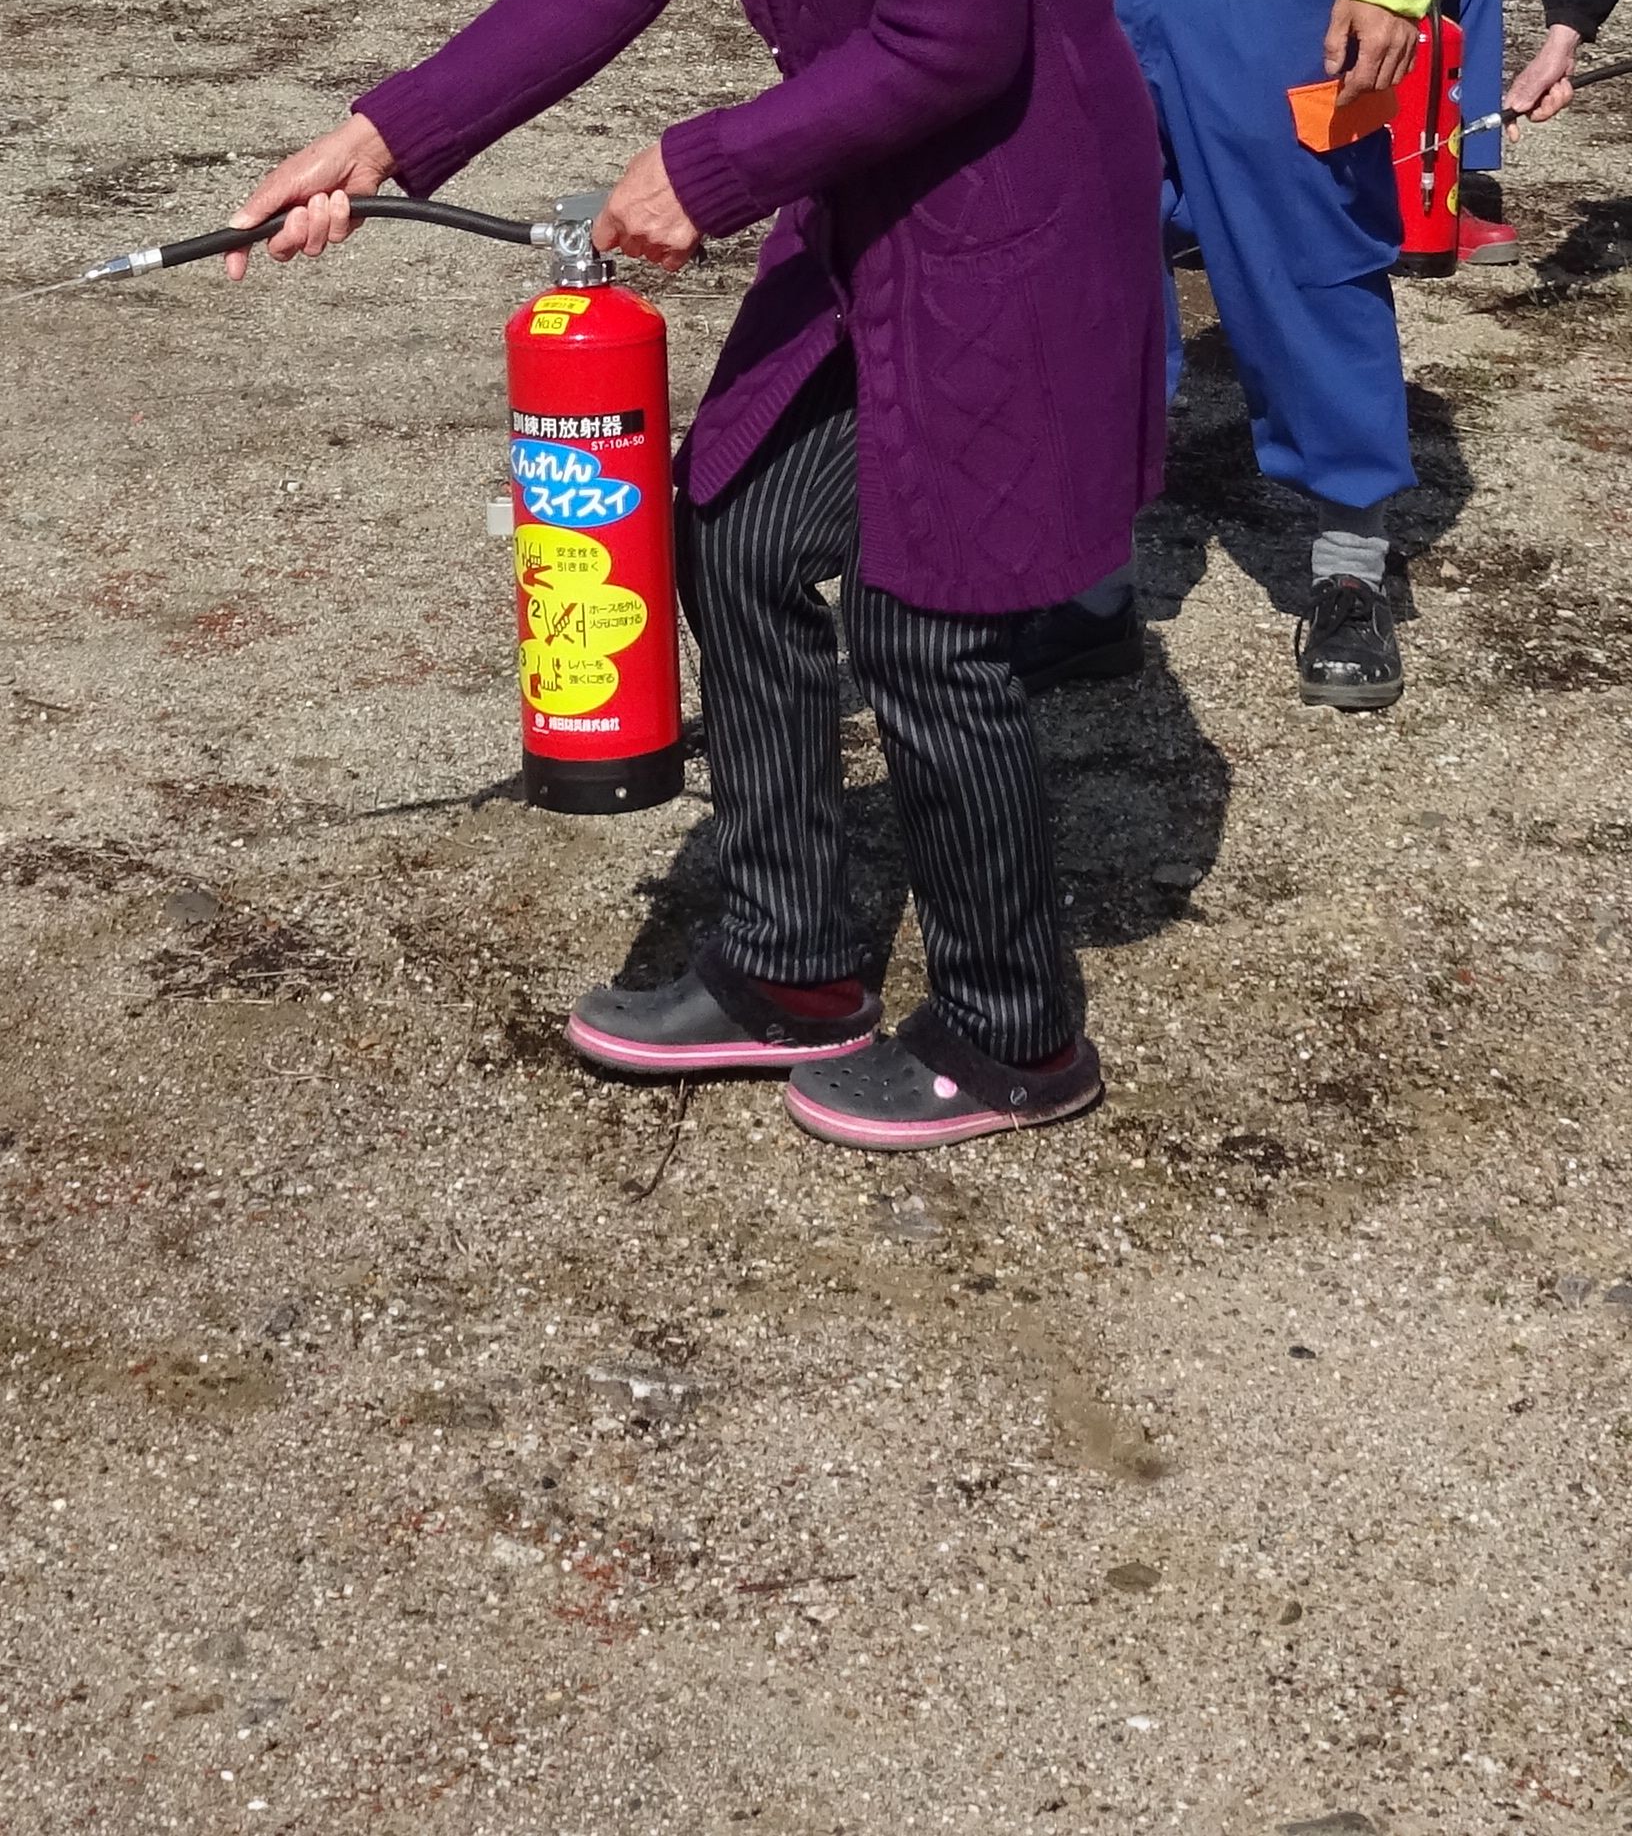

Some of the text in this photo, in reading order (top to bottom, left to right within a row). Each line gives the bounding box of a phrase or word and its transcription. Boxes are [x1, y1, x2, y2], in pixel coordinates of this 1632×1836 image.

[513, 411, 623, 438] 訓練用放射器
[511, 445, 592, 483] くんれん
[530, 485, 630, 517] スイスイ
[556, 547, 599, 557] 安全栓を
[531, 599, 541, 618] 2
[521, 648, 526, 666] 3
[568, 660, 603, 669] レバーを
